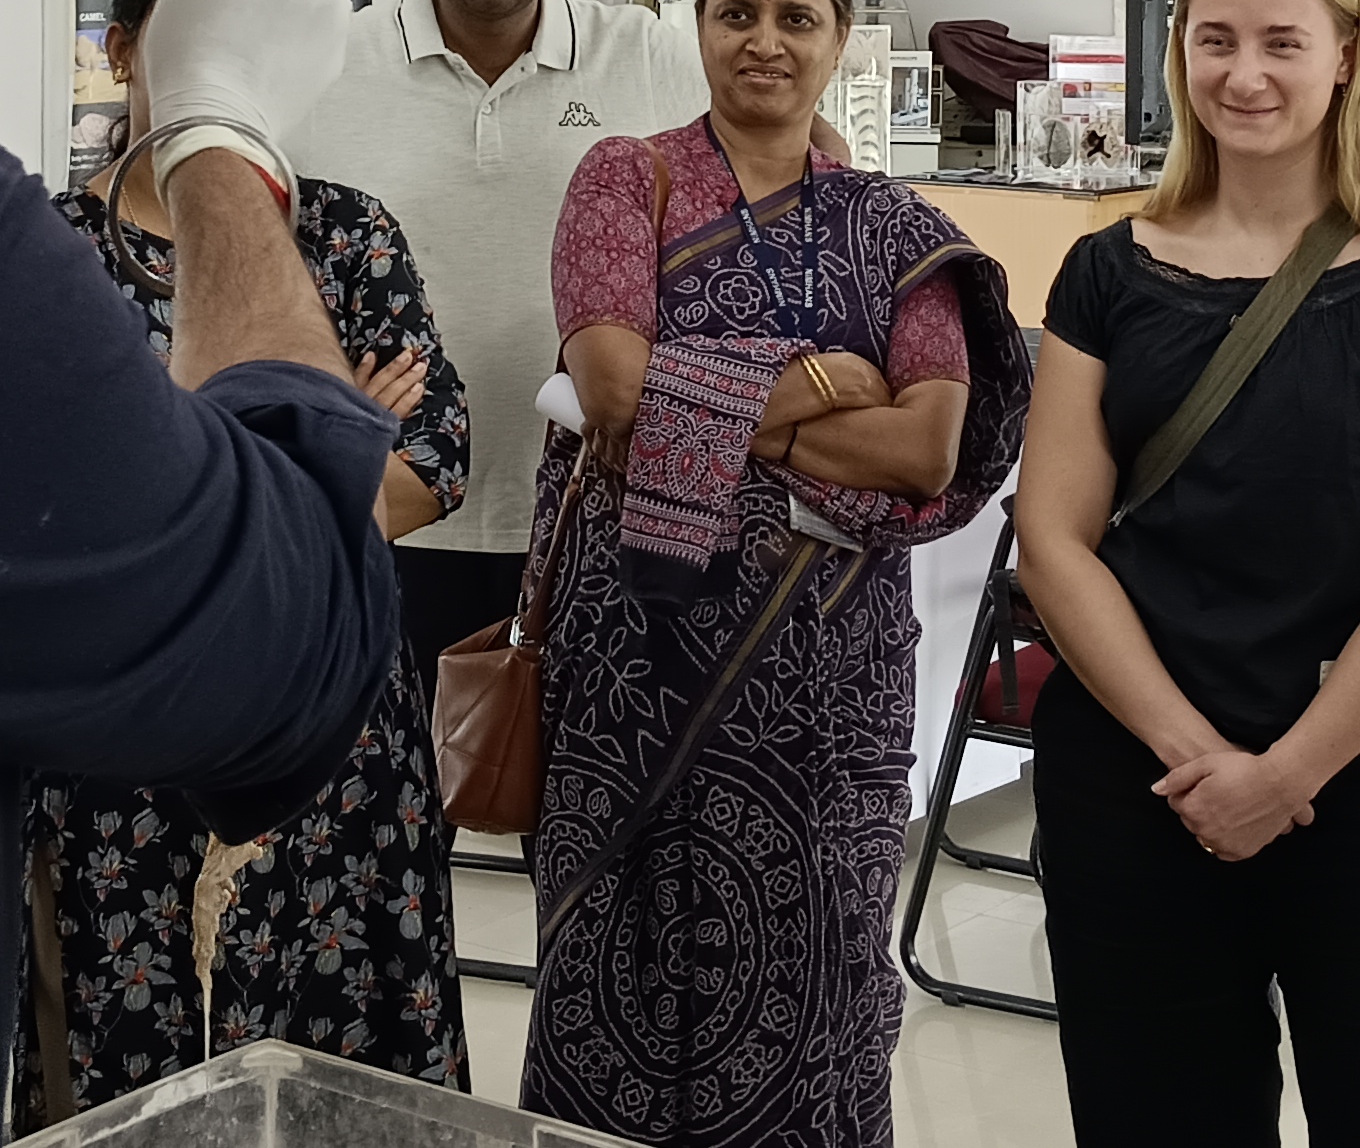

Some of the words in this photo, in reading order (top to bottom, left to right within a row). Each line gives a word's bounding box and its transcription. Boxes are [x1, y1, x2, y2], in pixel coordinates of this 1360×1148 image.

[80, 13, 106, 22] CAMEL
[766, 267, 786, 307] NIMHANS
[804, 268, 814, 308] NIMHANS
